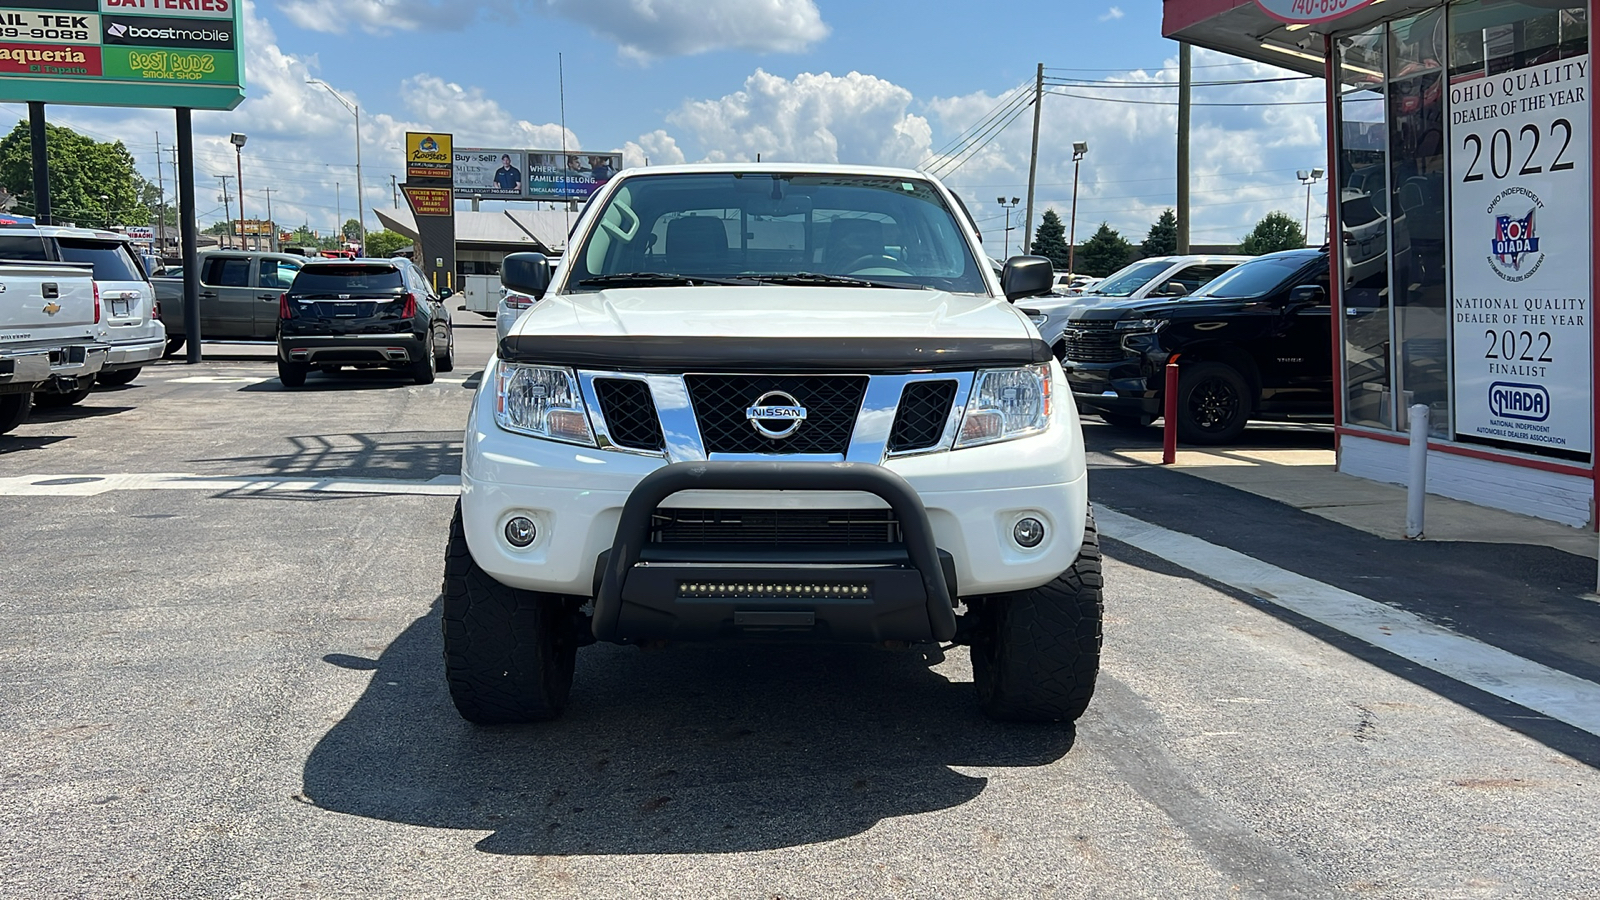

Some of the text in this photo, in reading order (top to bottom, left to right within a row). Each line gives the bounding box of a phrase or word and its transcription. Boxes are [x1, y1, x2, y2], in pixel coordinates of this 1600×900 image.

[38, 15, 89, 29] TEK
[0, 27, 88, 40] 9-9088
[29, 64, 41, 72] El
[143, 71, 202, 80] SMOKE SHOP
[1451, 60, 1587, 105] OHIO QUALITY
[1453, 86, 1585, 125] DEALER OF THE YEAR
[1463, 118, 1574, 183] 2022
[455, 154, 470, 162] Buy
[530, 165, 557, 173] WHERE
[530, 175, 564, 183] FAMILIES
[1486, 186, 1545, 214] OHIO INDEPENDENT
[1497, 239, 1531, 253] OIADA
[1455, 298, 1586, 311] NATIONAL QUALITY
[1457, 313, 1584, 326] DEALER OF THE YEAR
[1485, 329, 1553, 363] 2022
[1489, 363, 1546, 377] FINALIST
[1493, 389, 1544, 413] NIADA
[752, 408, 800, 417] NISSAN
[1490, 419, 1550, 433] NATIONAL INDEPENDENT
[1476, 427, 1566, 445] AUTOMOBILE DEALERS ASSOCIATION
